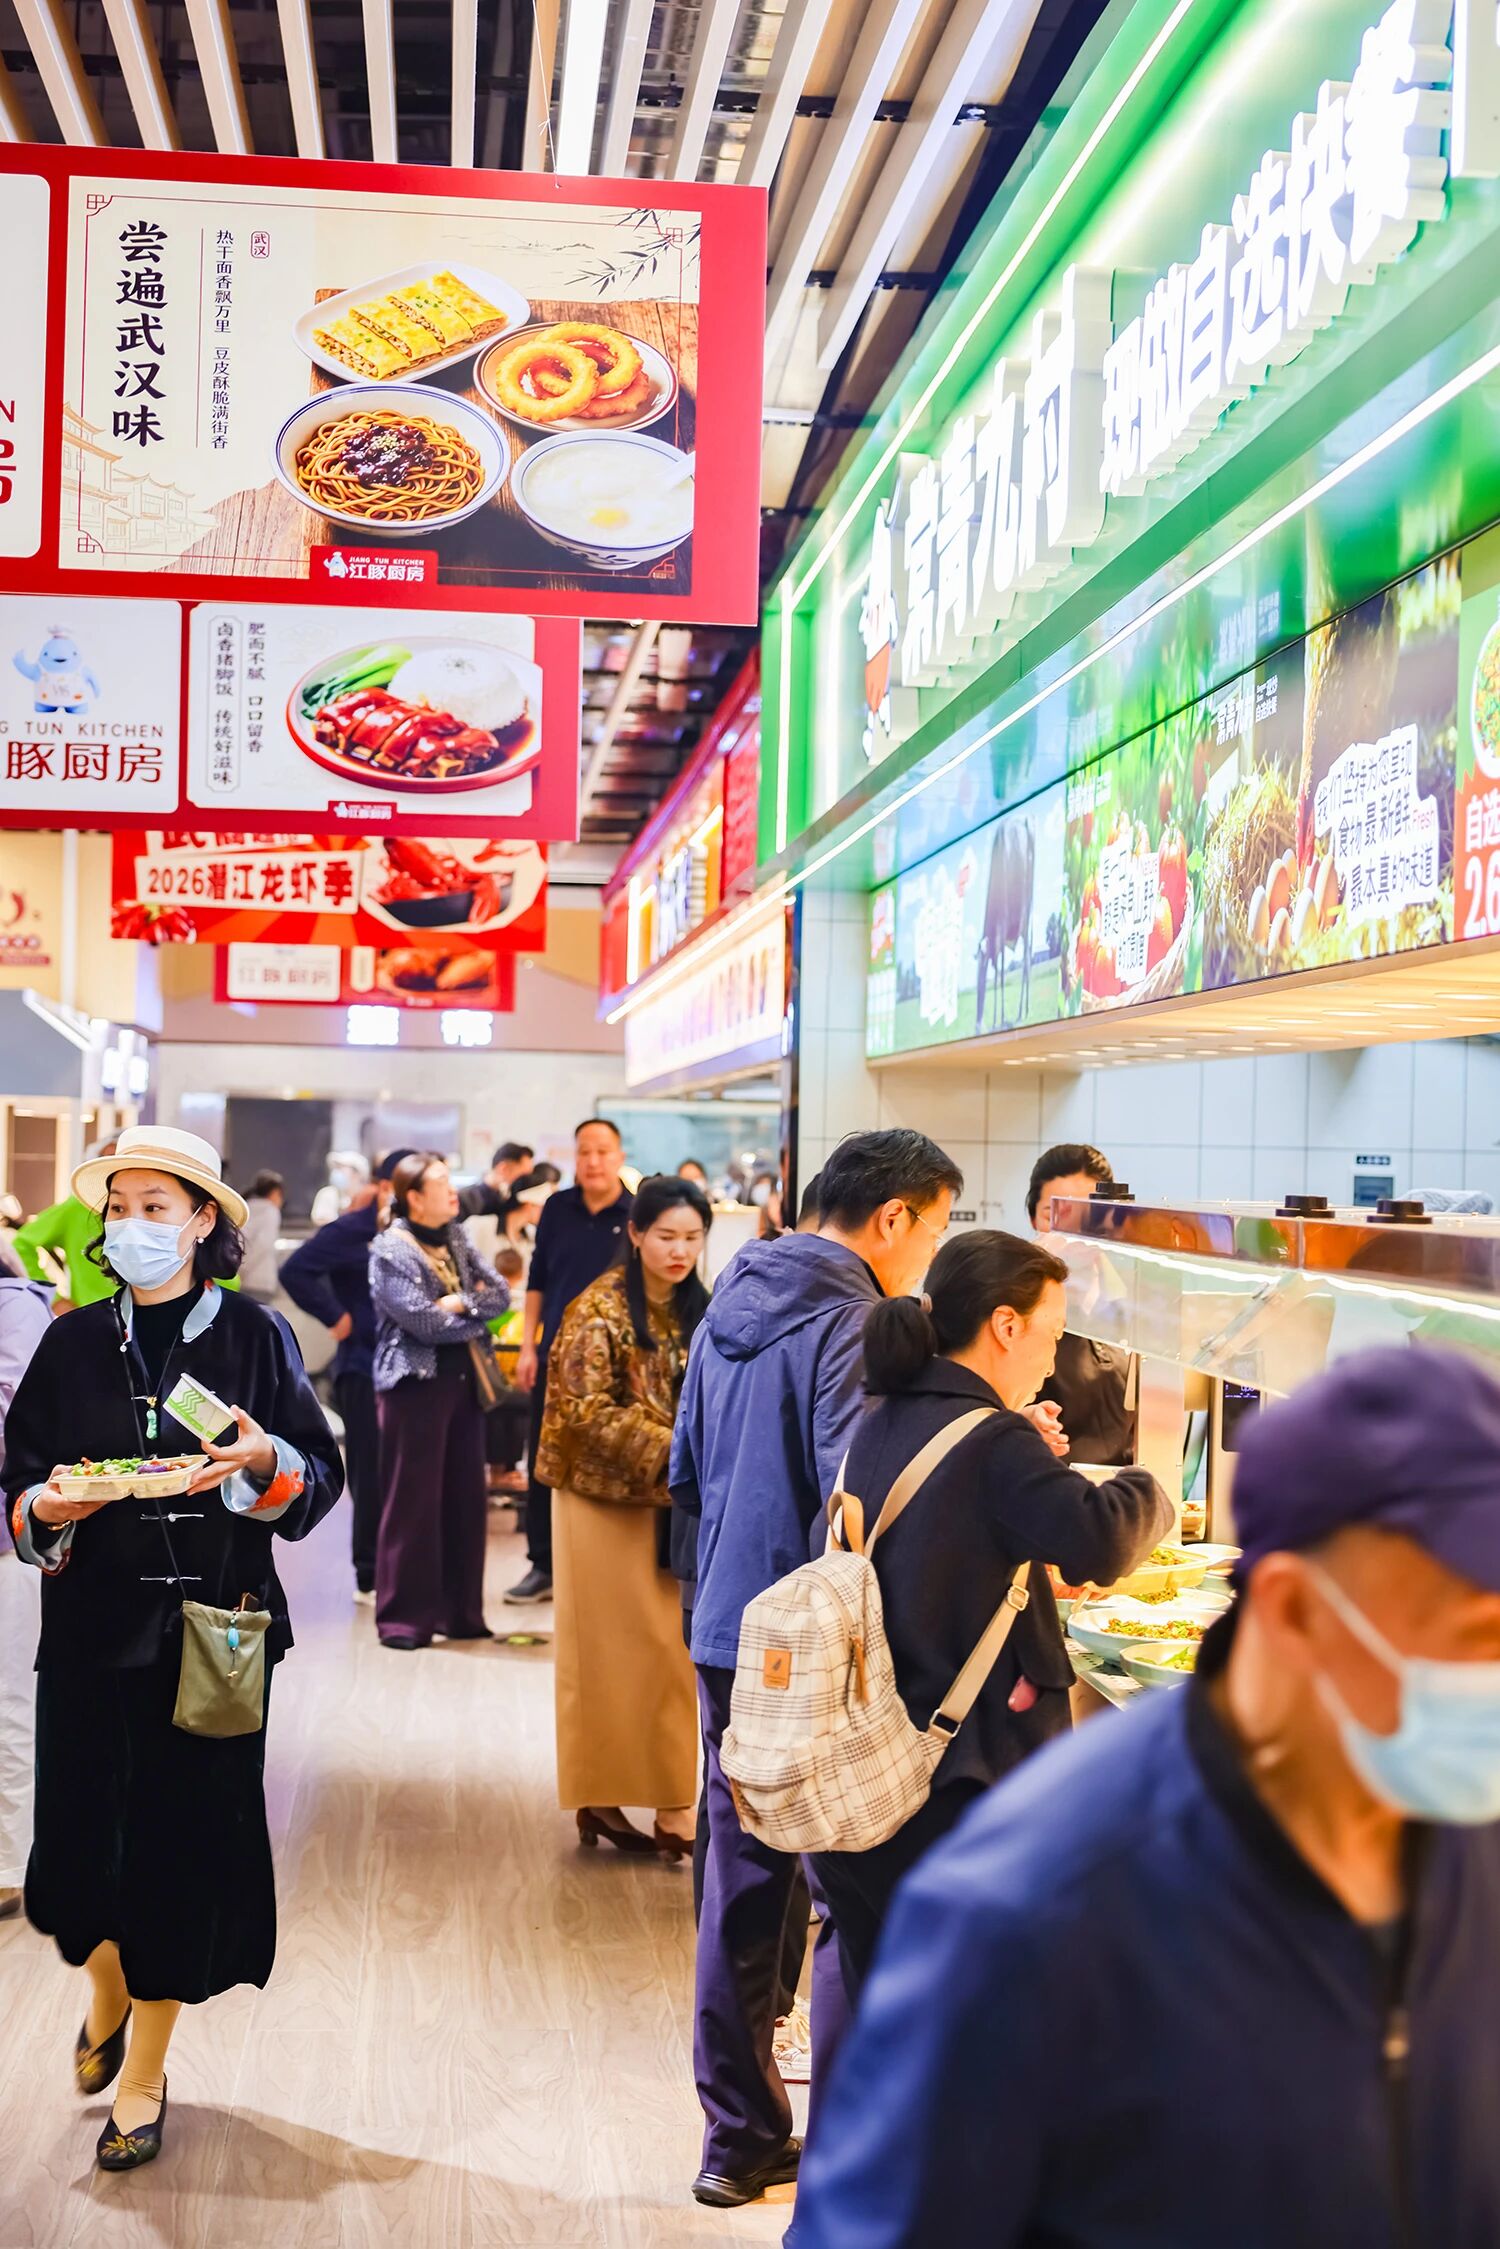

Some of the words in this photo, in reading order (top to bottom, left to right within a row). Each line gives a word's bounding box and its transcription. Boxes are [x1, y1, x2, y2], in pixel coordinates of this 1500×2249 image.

[253, 232, 267, 256] 武汉
[214, 229, 234, 334] 热干面香飘万里
[112, 220, 168, 448] 尝遍武汉味
[211, 346, 230, 450] 豆皮酥脆满街香
[349, 556, 370, 564] JIANG
[374, 557, 389, 565] TUN
[393, 558, 425, 566] KITCHEN
[349, 563, 425, 582] 江豚厨房
[215, 622, 234, 696] 卤香猪脚饭
[247, 622, 266, 681] 肥而不腻
[25, 721, 63, 735] TUN
[78, 722, 164, 738] KITCHEN
[213, 709, 234, 785] 传统好滋味
[247, 695, 264, 753] 口口留香
[5, 741, 164, 783] 豚厨房
[1317, 740, 1413, 825] 我们坚持为您呈现
[1338, 784, 1411, 858] 食物最新鲜
[149, 861, 353, 906] 2026潜江龙虾季
[1350, 841, 1434, 912] 最本真的味道
